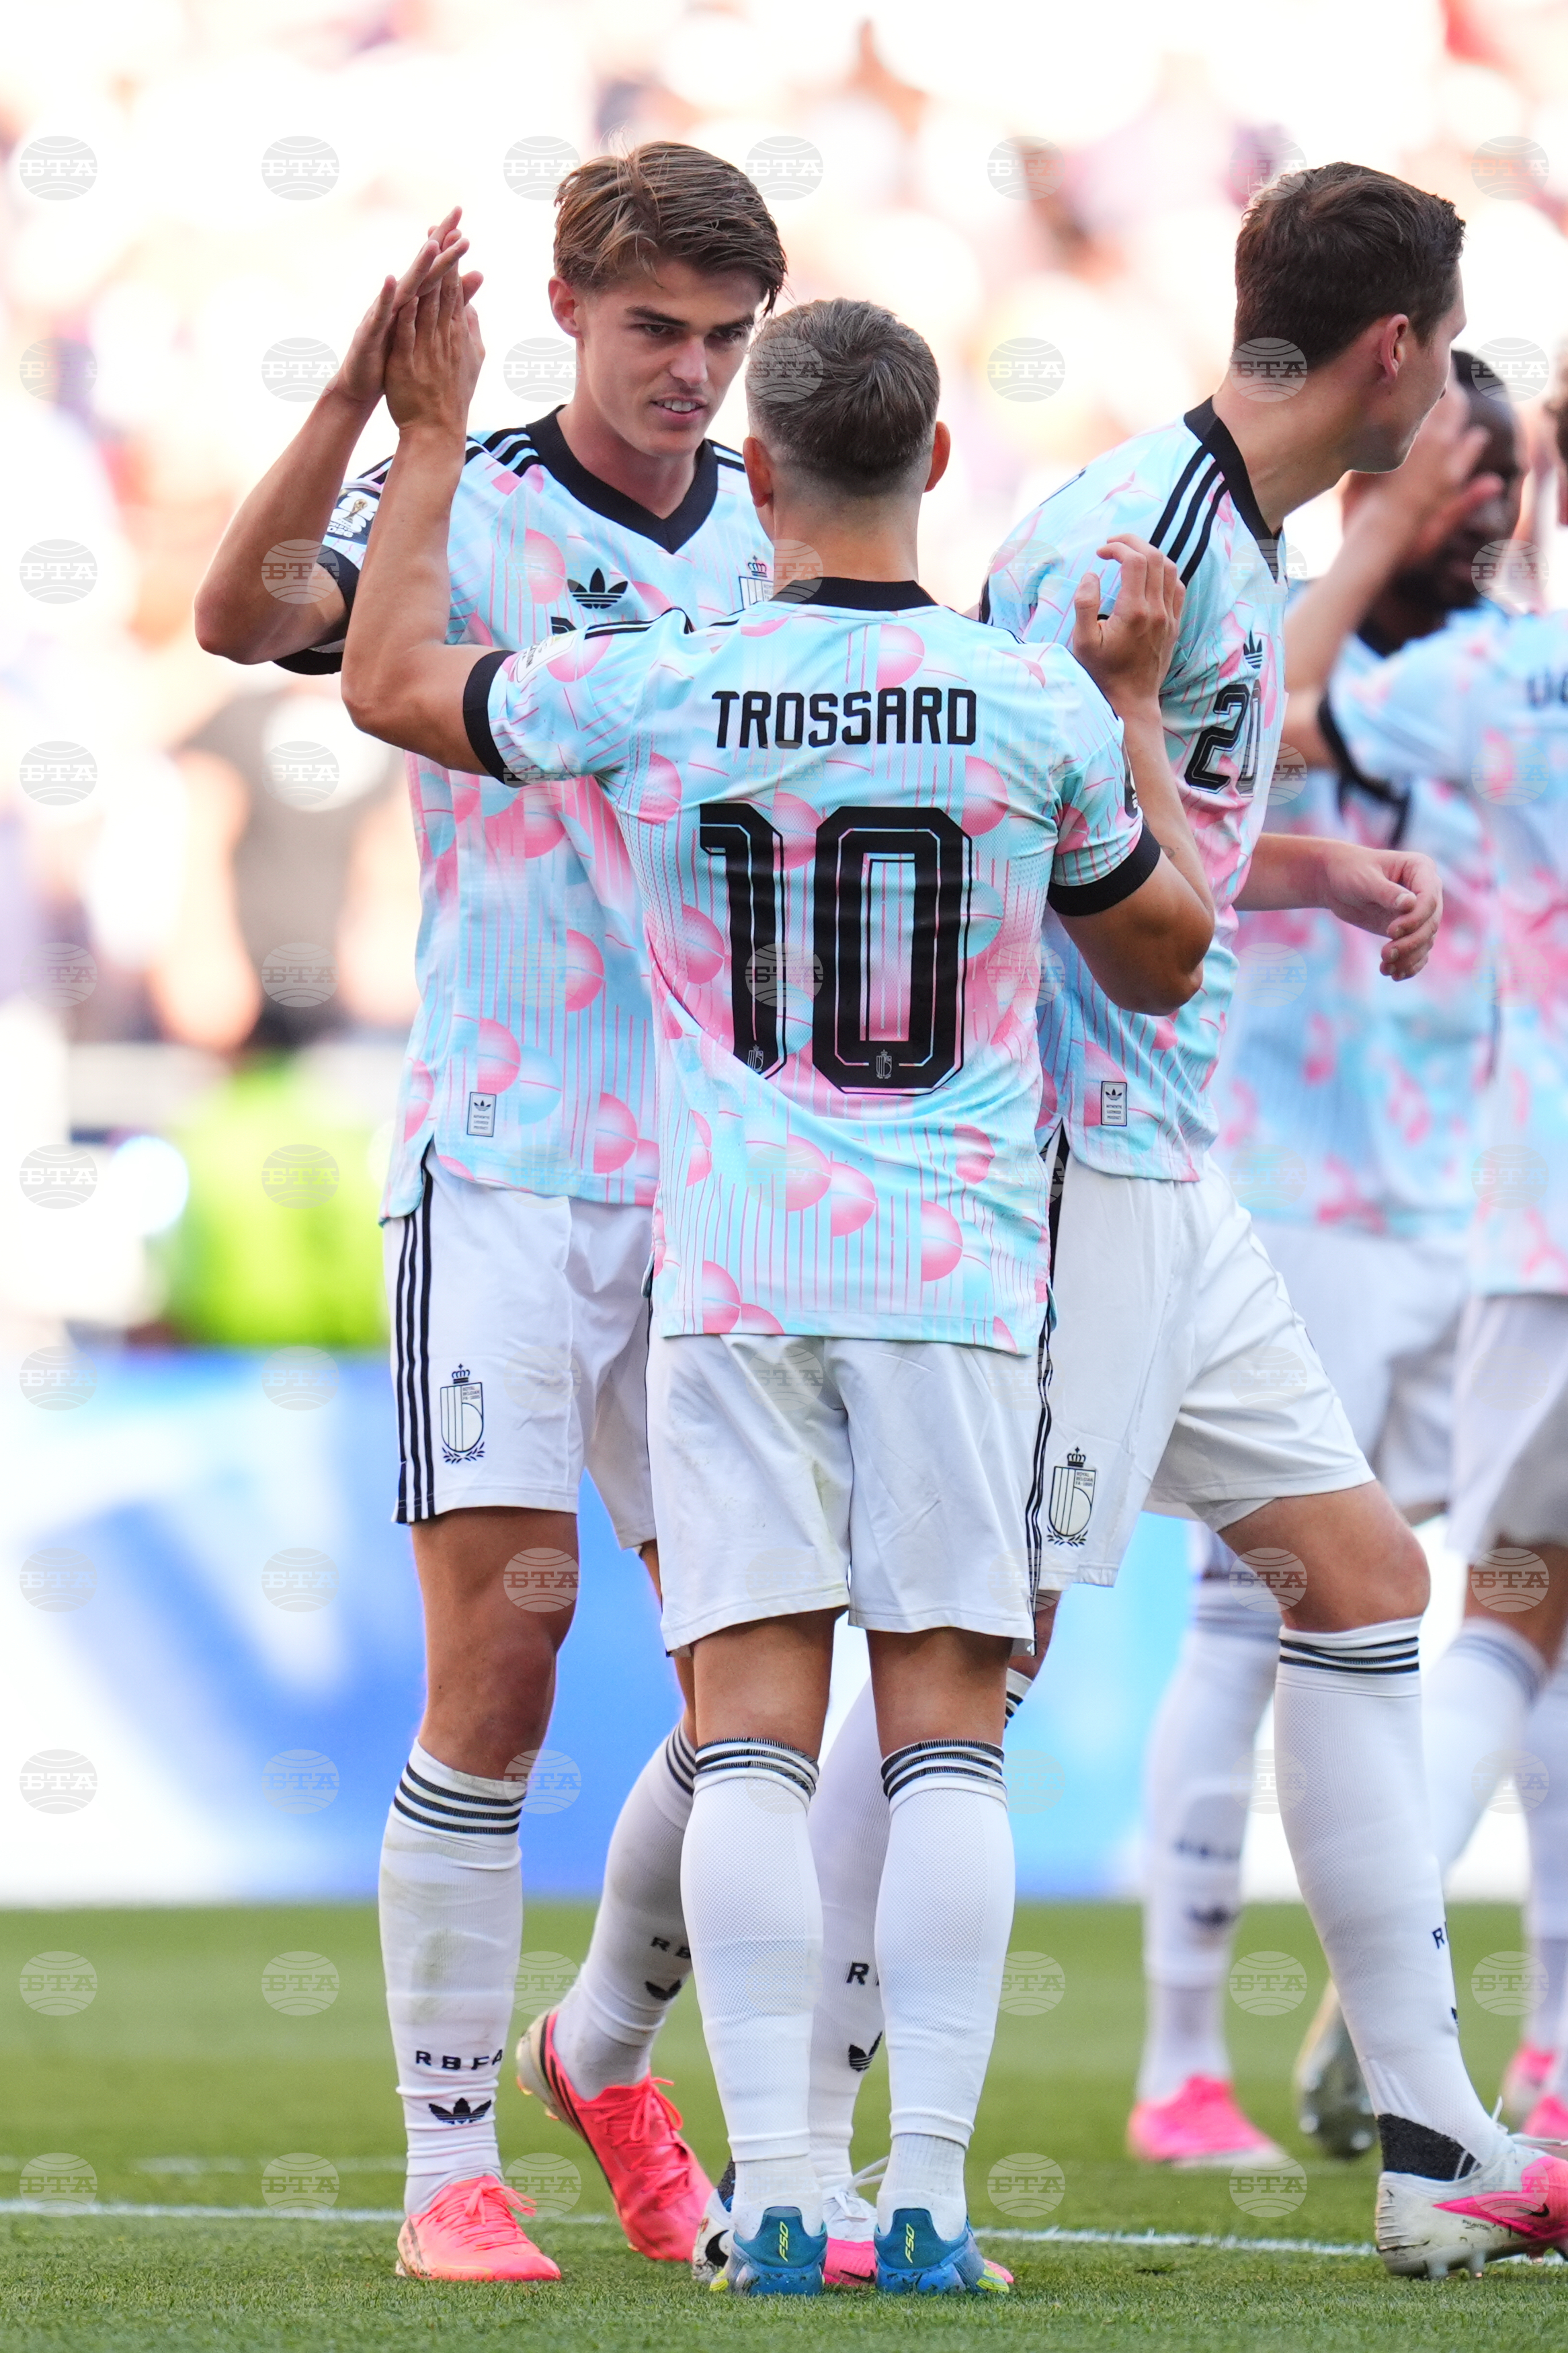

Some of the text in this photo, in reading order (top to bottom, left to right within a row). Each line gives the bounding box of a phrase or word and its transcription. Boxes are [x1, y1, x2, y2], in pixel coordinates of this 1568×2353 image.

[712, 688, 977, 749] TROSSARD
[700, 803, 972, 1096] 10
[846, 1962, 879, 1985] R
[415, 2048, 503, 2070] RBFA
[779, 2221, 789, 2262] F50
[905, 2223, 915, 2264] F50
